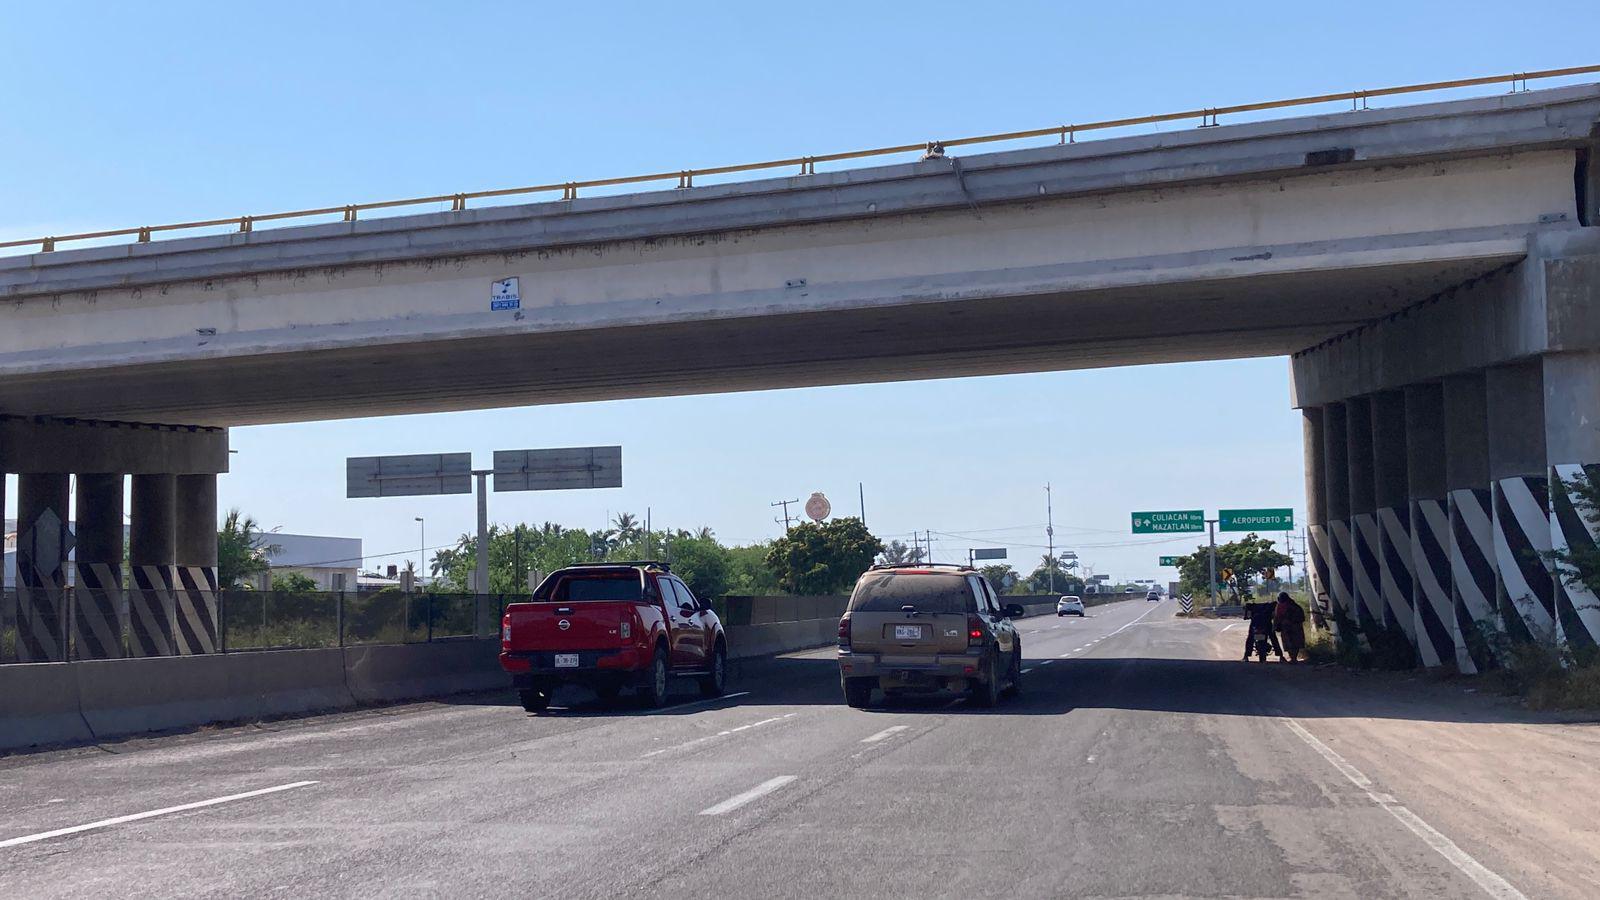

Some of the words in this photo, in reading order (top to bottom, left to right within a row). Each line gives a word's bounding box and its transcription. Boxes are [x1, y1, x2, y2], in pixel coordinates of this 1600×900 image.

[1152, 513, 1188, 521] CULIACAN
[1232, 515, 1280, 525] AEROPUERTO
[1152, 523, 1190, 531] MAZATLAN
